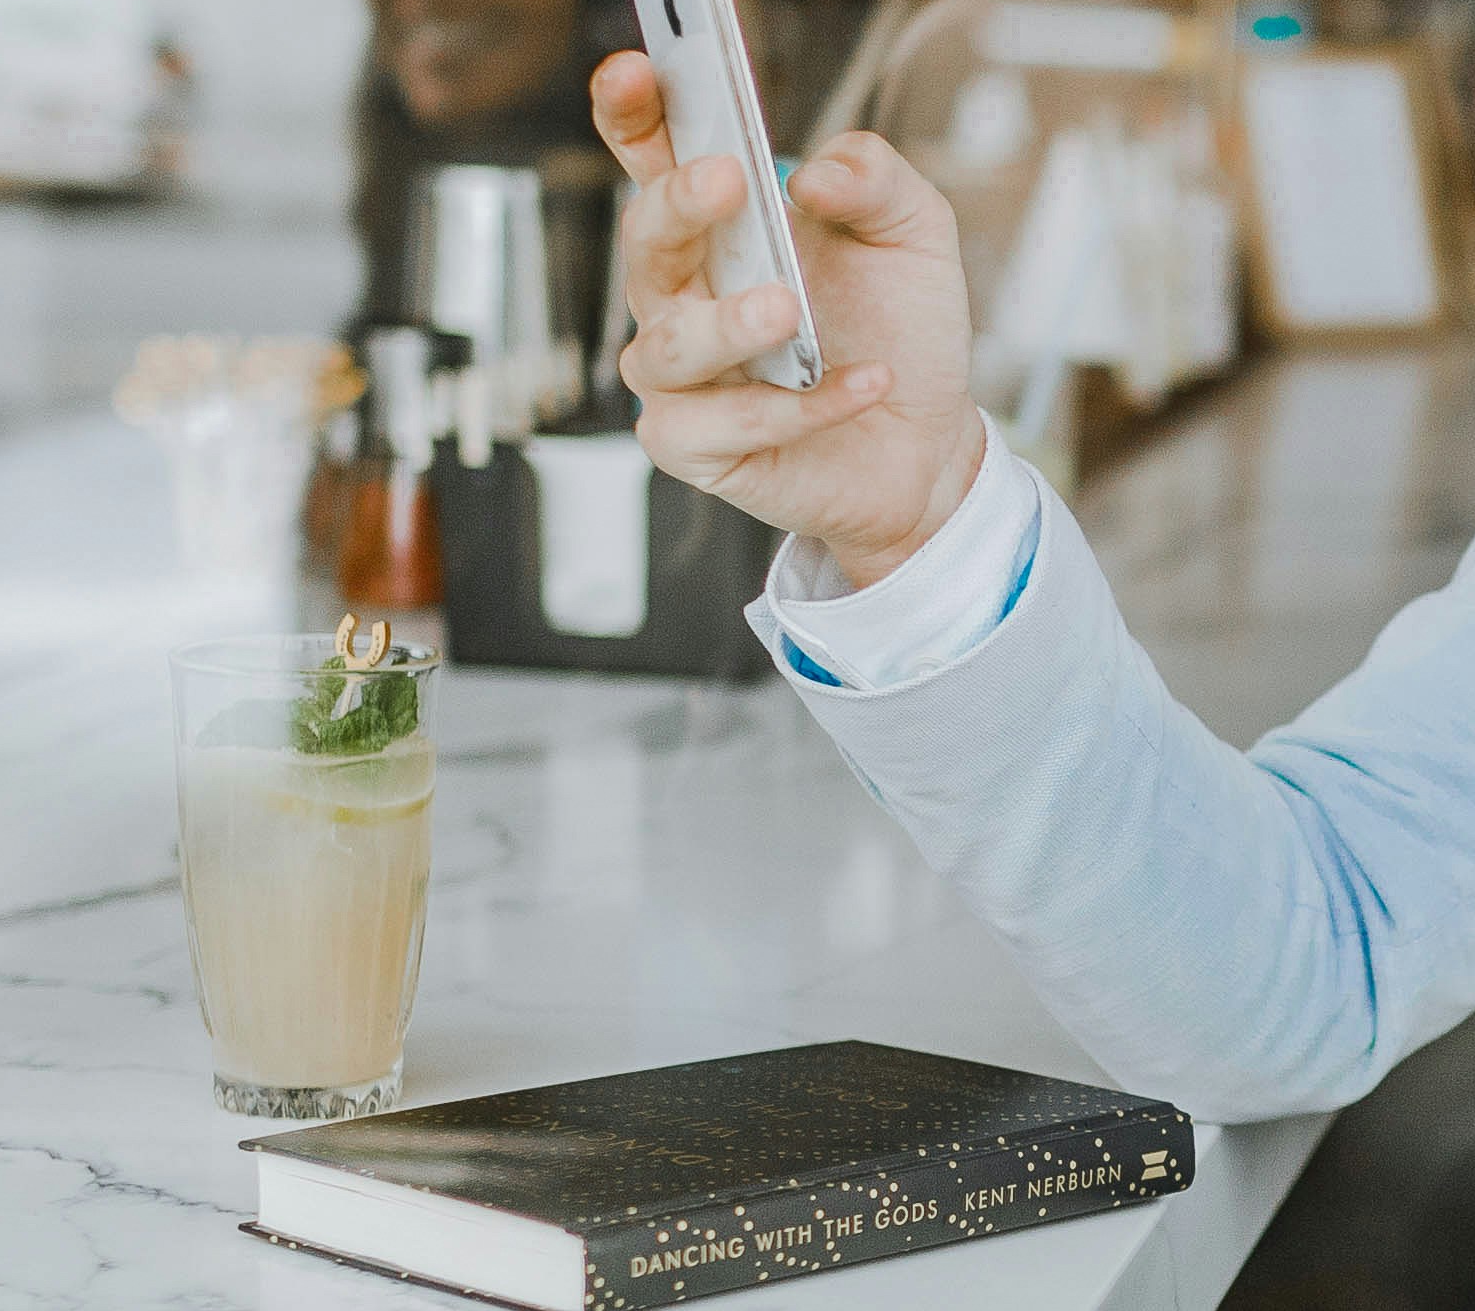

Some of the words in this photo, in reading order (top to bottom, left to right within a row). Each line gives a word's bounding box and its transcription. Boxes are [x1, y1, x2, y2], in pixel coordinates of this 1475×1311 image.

[630, 1237, 746, 1278] DANCING
[755, 1223, 813, 1252] WITH
[823, 1214, 865, 1239] THE
[875, 1199, 938, 1231] GODS
[965, 1184, 1017, 1212] KENT
[1027, 1163, 1122, 1200] NERBURN
